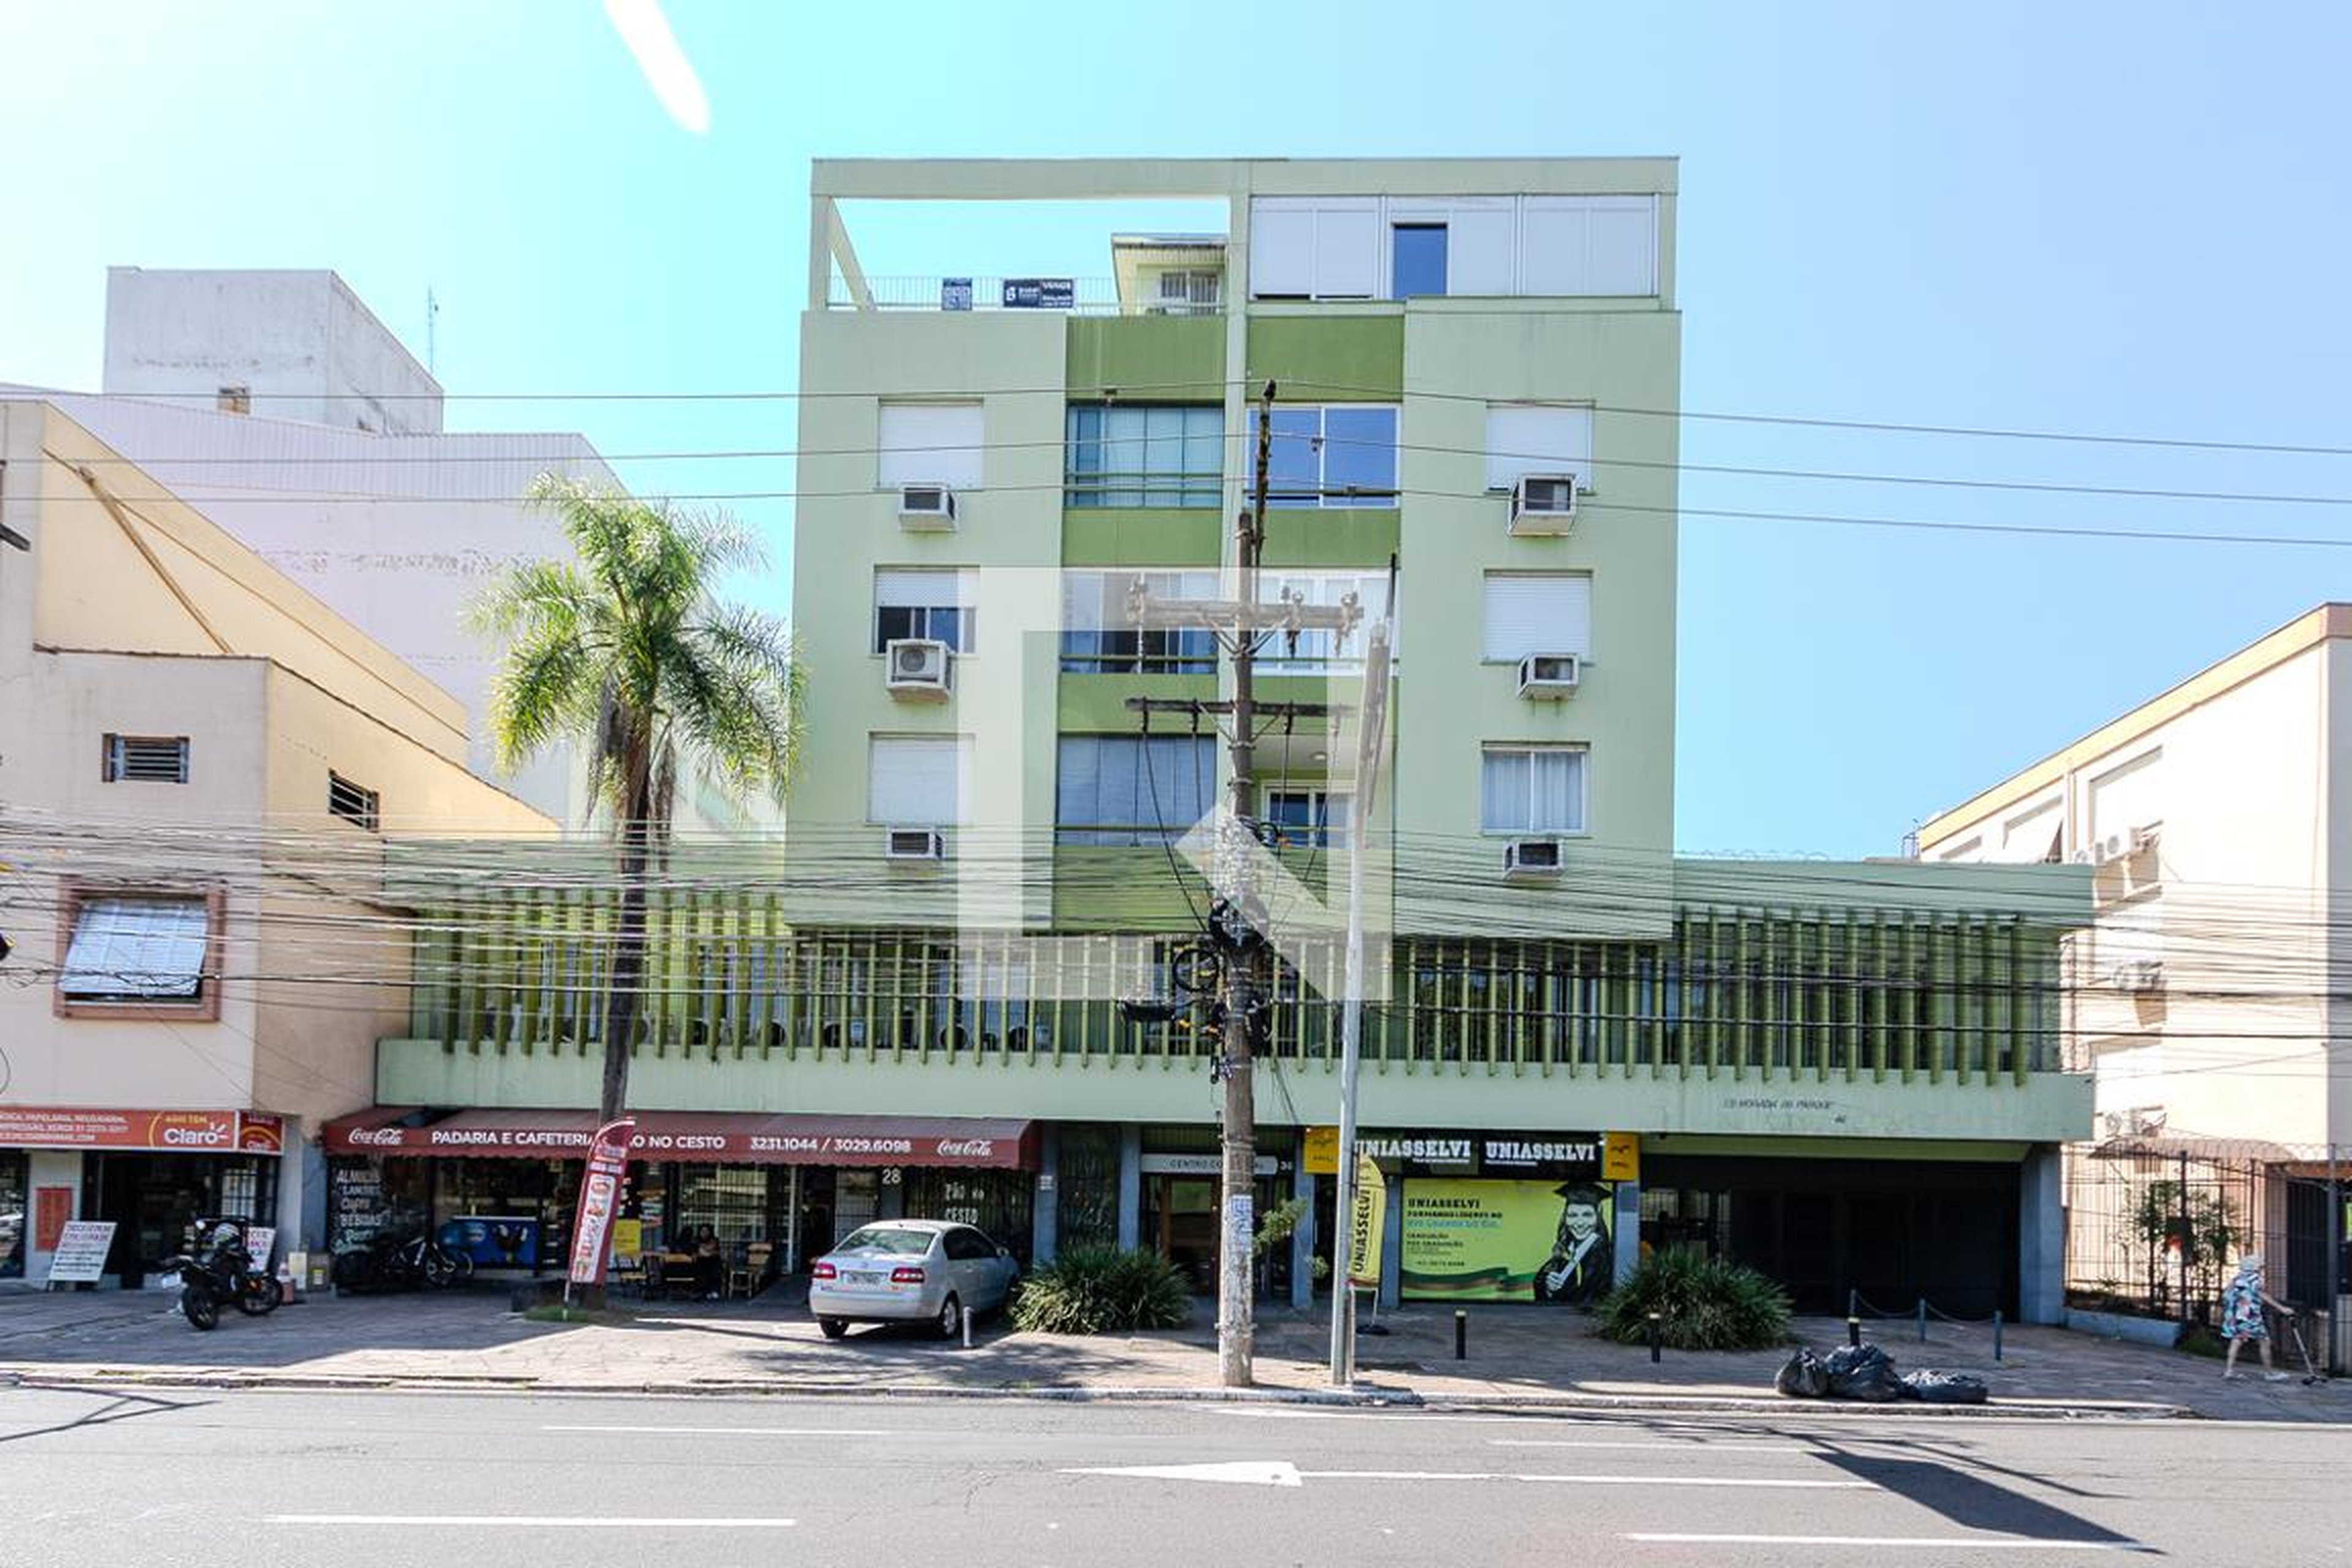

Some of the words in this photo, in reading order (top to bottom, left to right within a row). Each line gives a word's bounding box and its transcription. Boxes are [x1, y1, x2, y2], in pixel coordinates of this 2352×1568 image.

[164, 1128, 219, 1144] Claro
[348, 1128, 404, 1146] Coca-Cola
[431, 1131, 498, 1145] PADARIA
[501, 1133, 512, 1144] E
[649, 1136, 673, 1148] NO
[676, 1136, 726, 1150] CESTO
[750, 1136, 818, 1152] 3231.1044
[834, 1138, 913, 1154] 3029.6098
[937, 1139, 993, 1157] Coca-Cola
[1485, 1140, 1596, 1161] UNIASSELVI
[881, 1167, 902, 1185] 28
[1408, 1199, 1480, 1209] UNIASSELVI
[1353, 1189, 1370, 1273] UNIASSELVI
